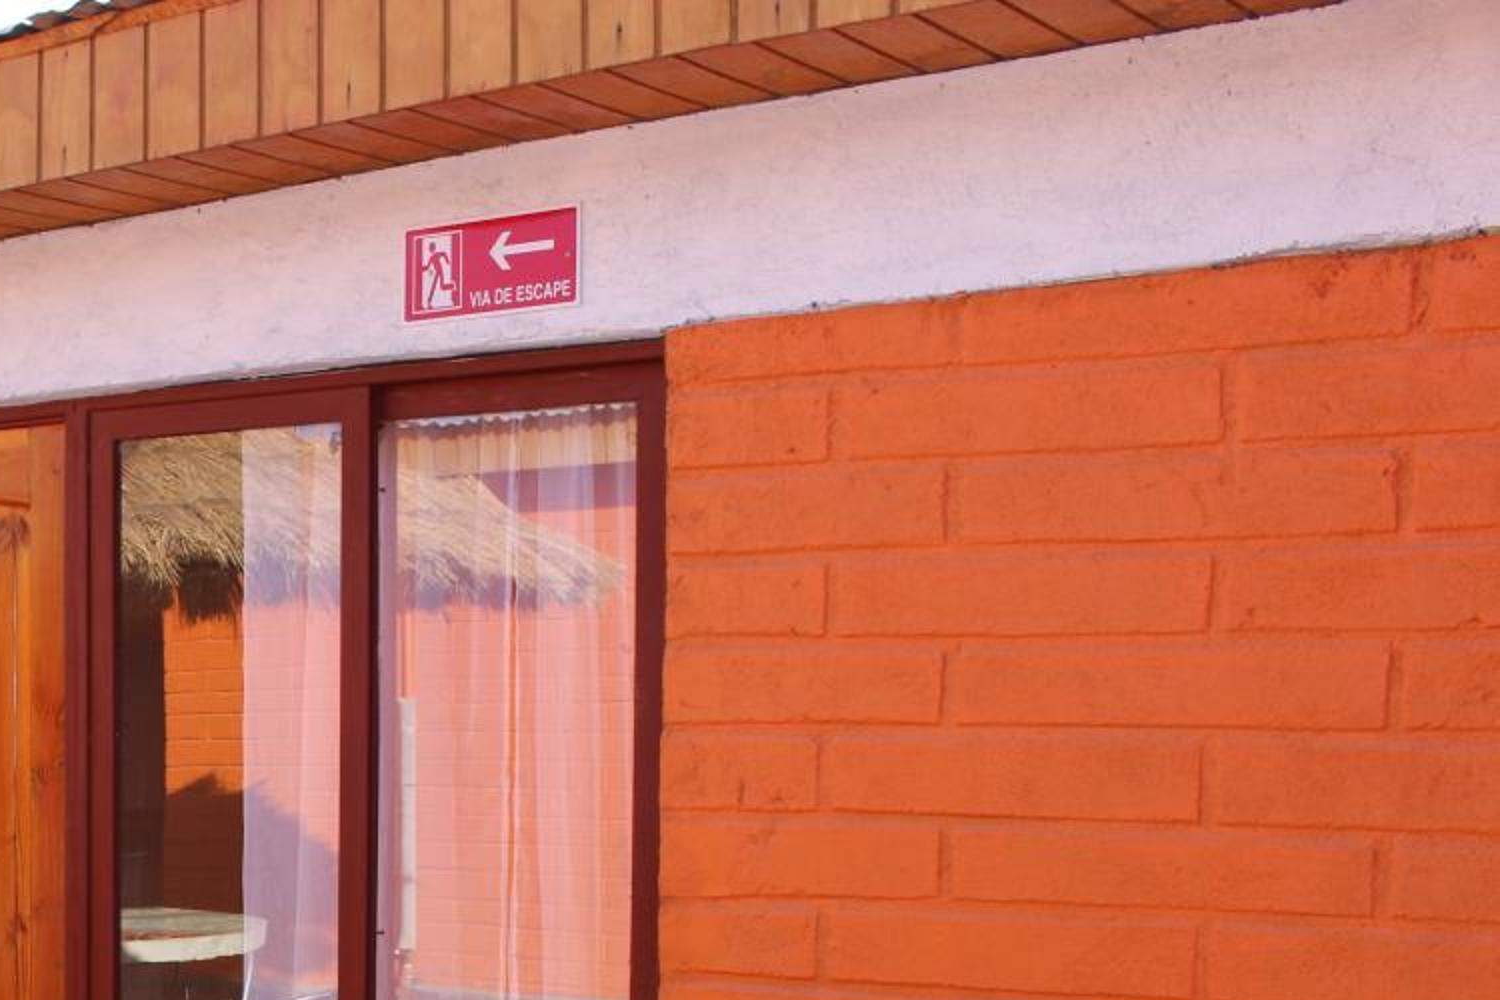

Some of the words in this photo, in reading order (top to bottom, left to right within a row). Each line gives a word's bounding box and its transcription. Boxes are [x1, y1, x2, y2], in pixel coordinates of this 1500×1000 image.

[469, 290, 491, 308] VIA
[494, 287, 513, 304] DE
[515, 279, 572, 302] ESCAPE
